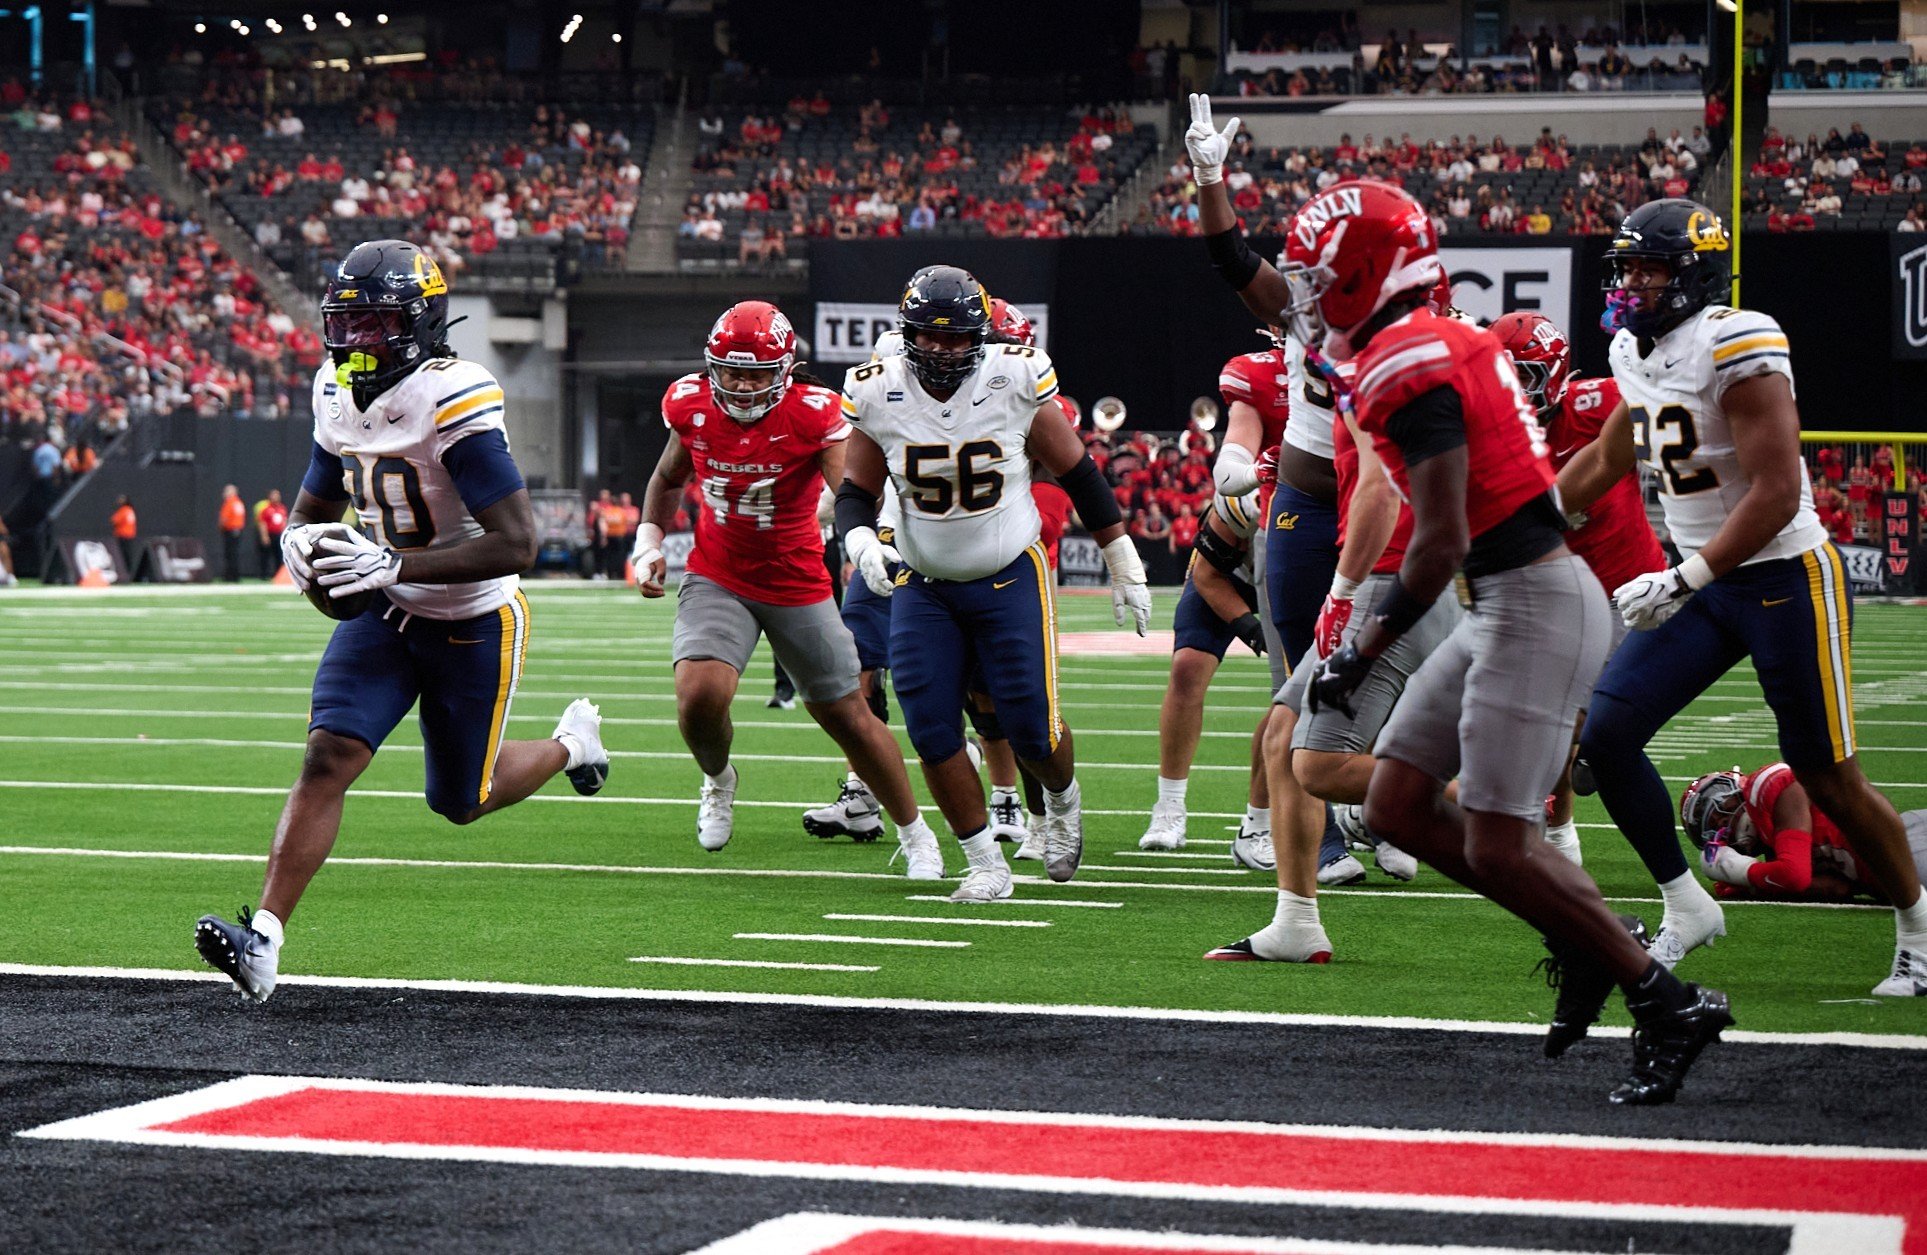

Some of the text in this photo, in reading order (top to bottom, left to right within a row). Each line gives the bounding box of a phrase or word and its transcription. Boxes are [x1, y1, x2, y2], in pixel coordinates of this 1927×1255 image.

[1295, 187, 1364, 251] UNLV
[706, 458, 783, 474] REBELS
[905, 439, 1006, 518] 56
[700, 475, 778, 531] 44
[1275, 511, 1300, 530] Cal
[1886, 498, 1909, 576] UNLV
